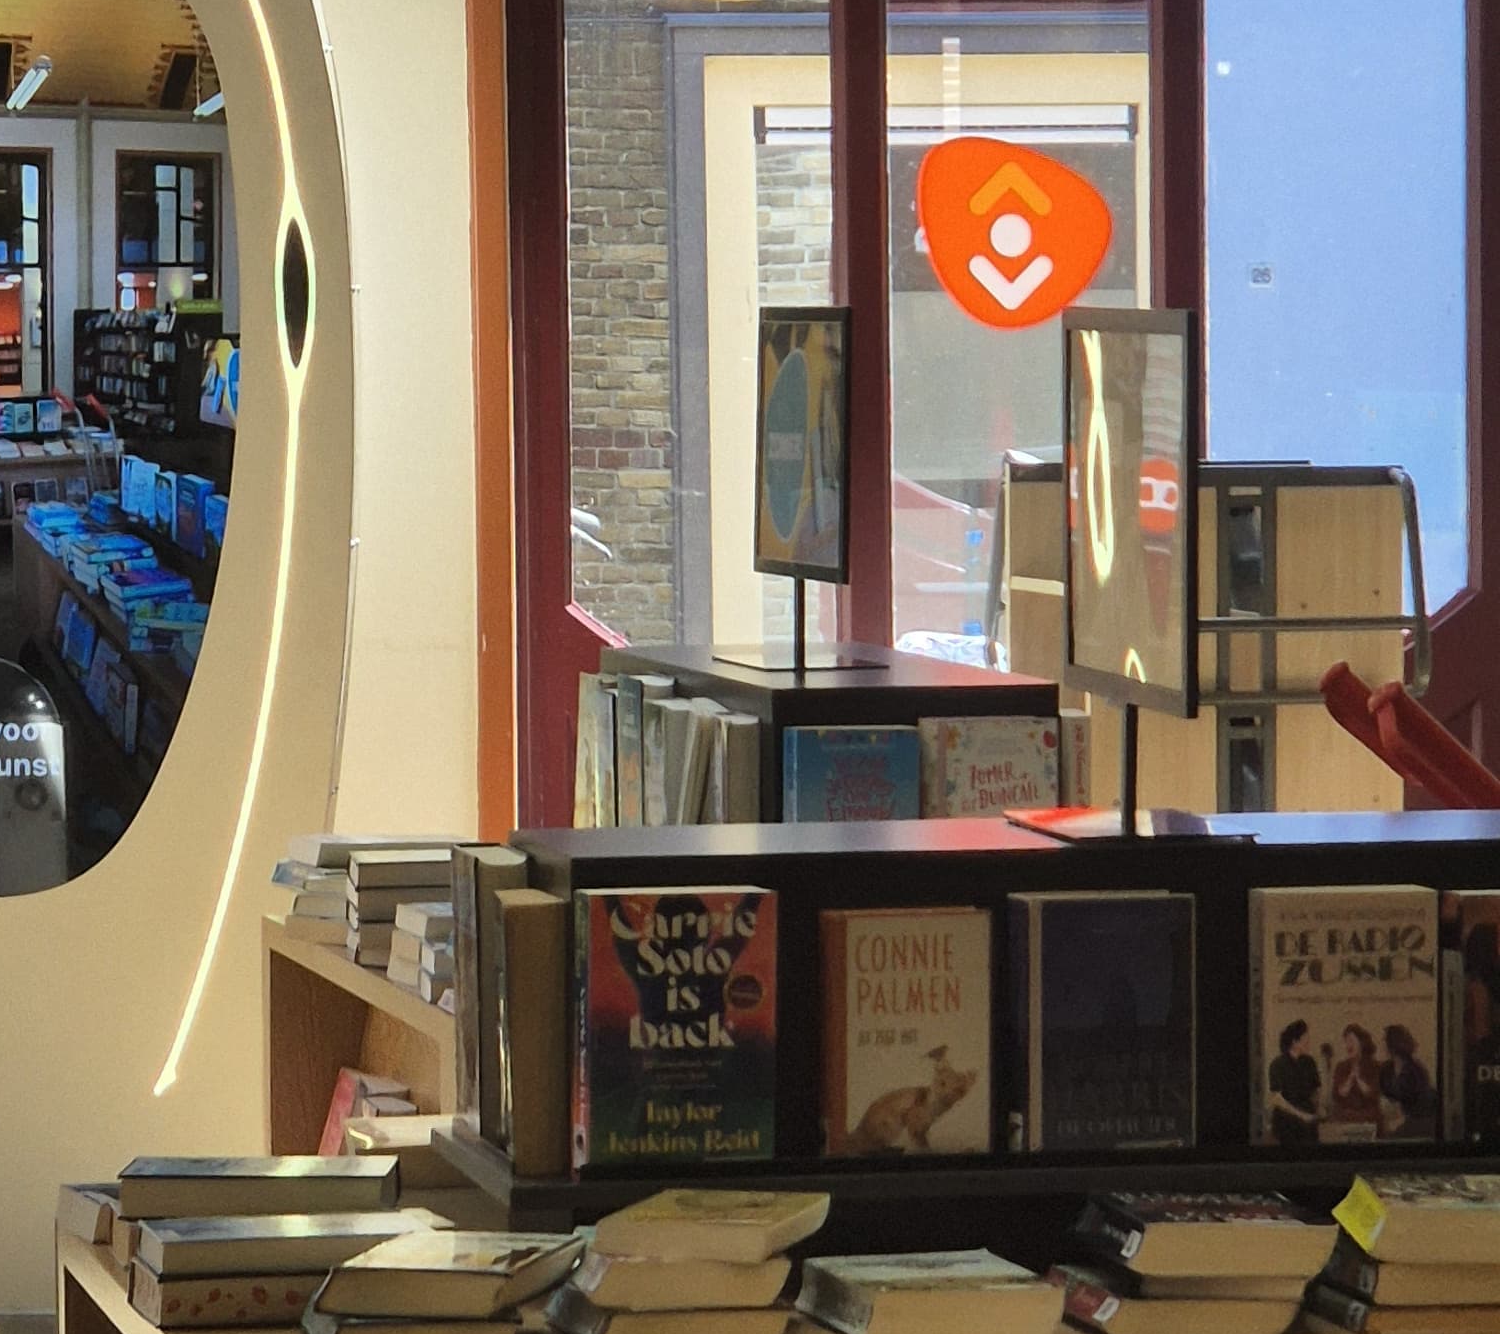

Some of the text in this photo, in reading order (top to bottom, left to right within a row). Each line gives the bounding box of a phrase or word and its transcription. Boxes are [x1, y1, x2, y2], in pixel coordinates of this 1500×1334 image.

[610, 903, 757, 940] Carrie
[1274, 923, 1426, 957] DE RADIO
[636, 938, 732, 977] Soto
[854, 933, 955, 972] CONNIE
[666, 976, 701, 1012] is
[856, 975, 961, 1014] PALMEN
[629, 1011, 736, 1049] back
